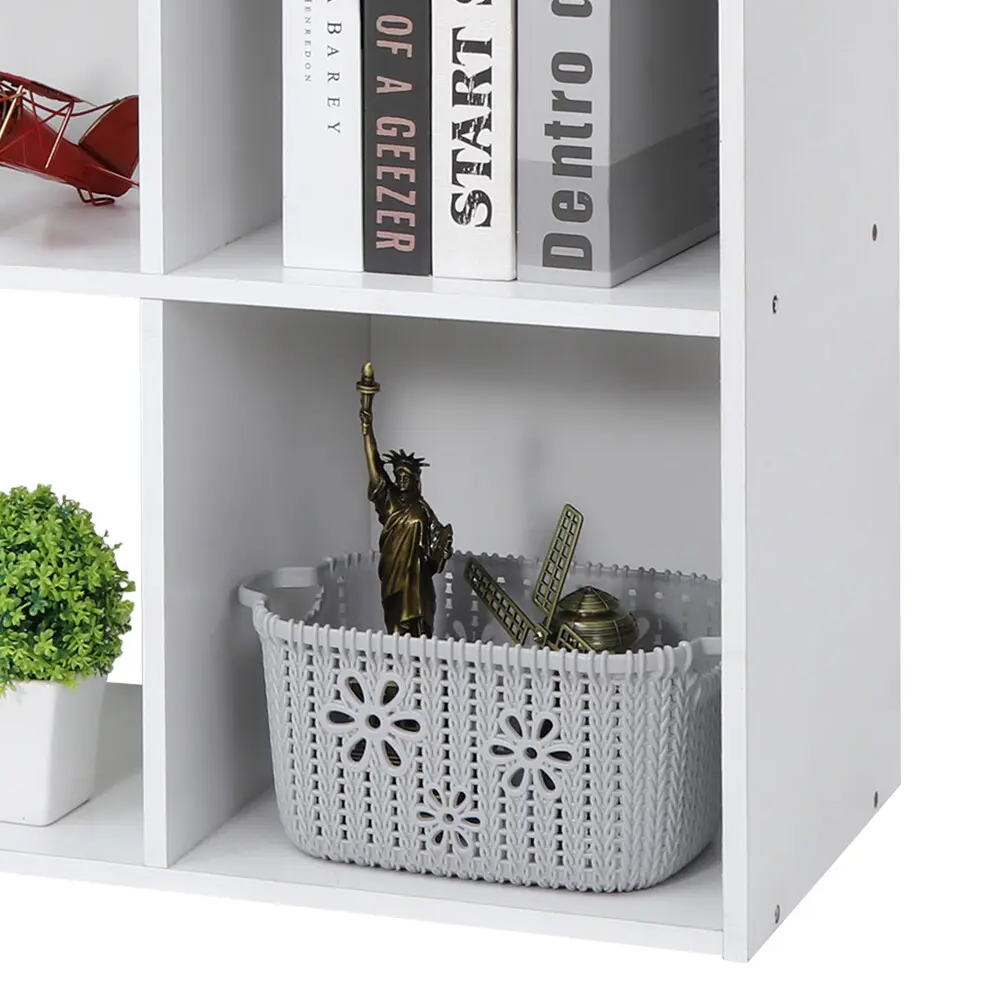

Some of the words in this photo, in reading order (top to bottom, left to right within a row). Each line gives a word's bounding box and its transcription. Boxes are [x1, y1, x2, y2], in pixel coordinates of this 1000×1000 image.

[327, 21, 343, 134] BAREY
[376, 14, 414, 58] OF
[376, 75, 413, 94] A
[376, 116, 417, 253] GEEZER
[450, 25, 493, 228] START
[542, 51, 594, 272] Dentro
